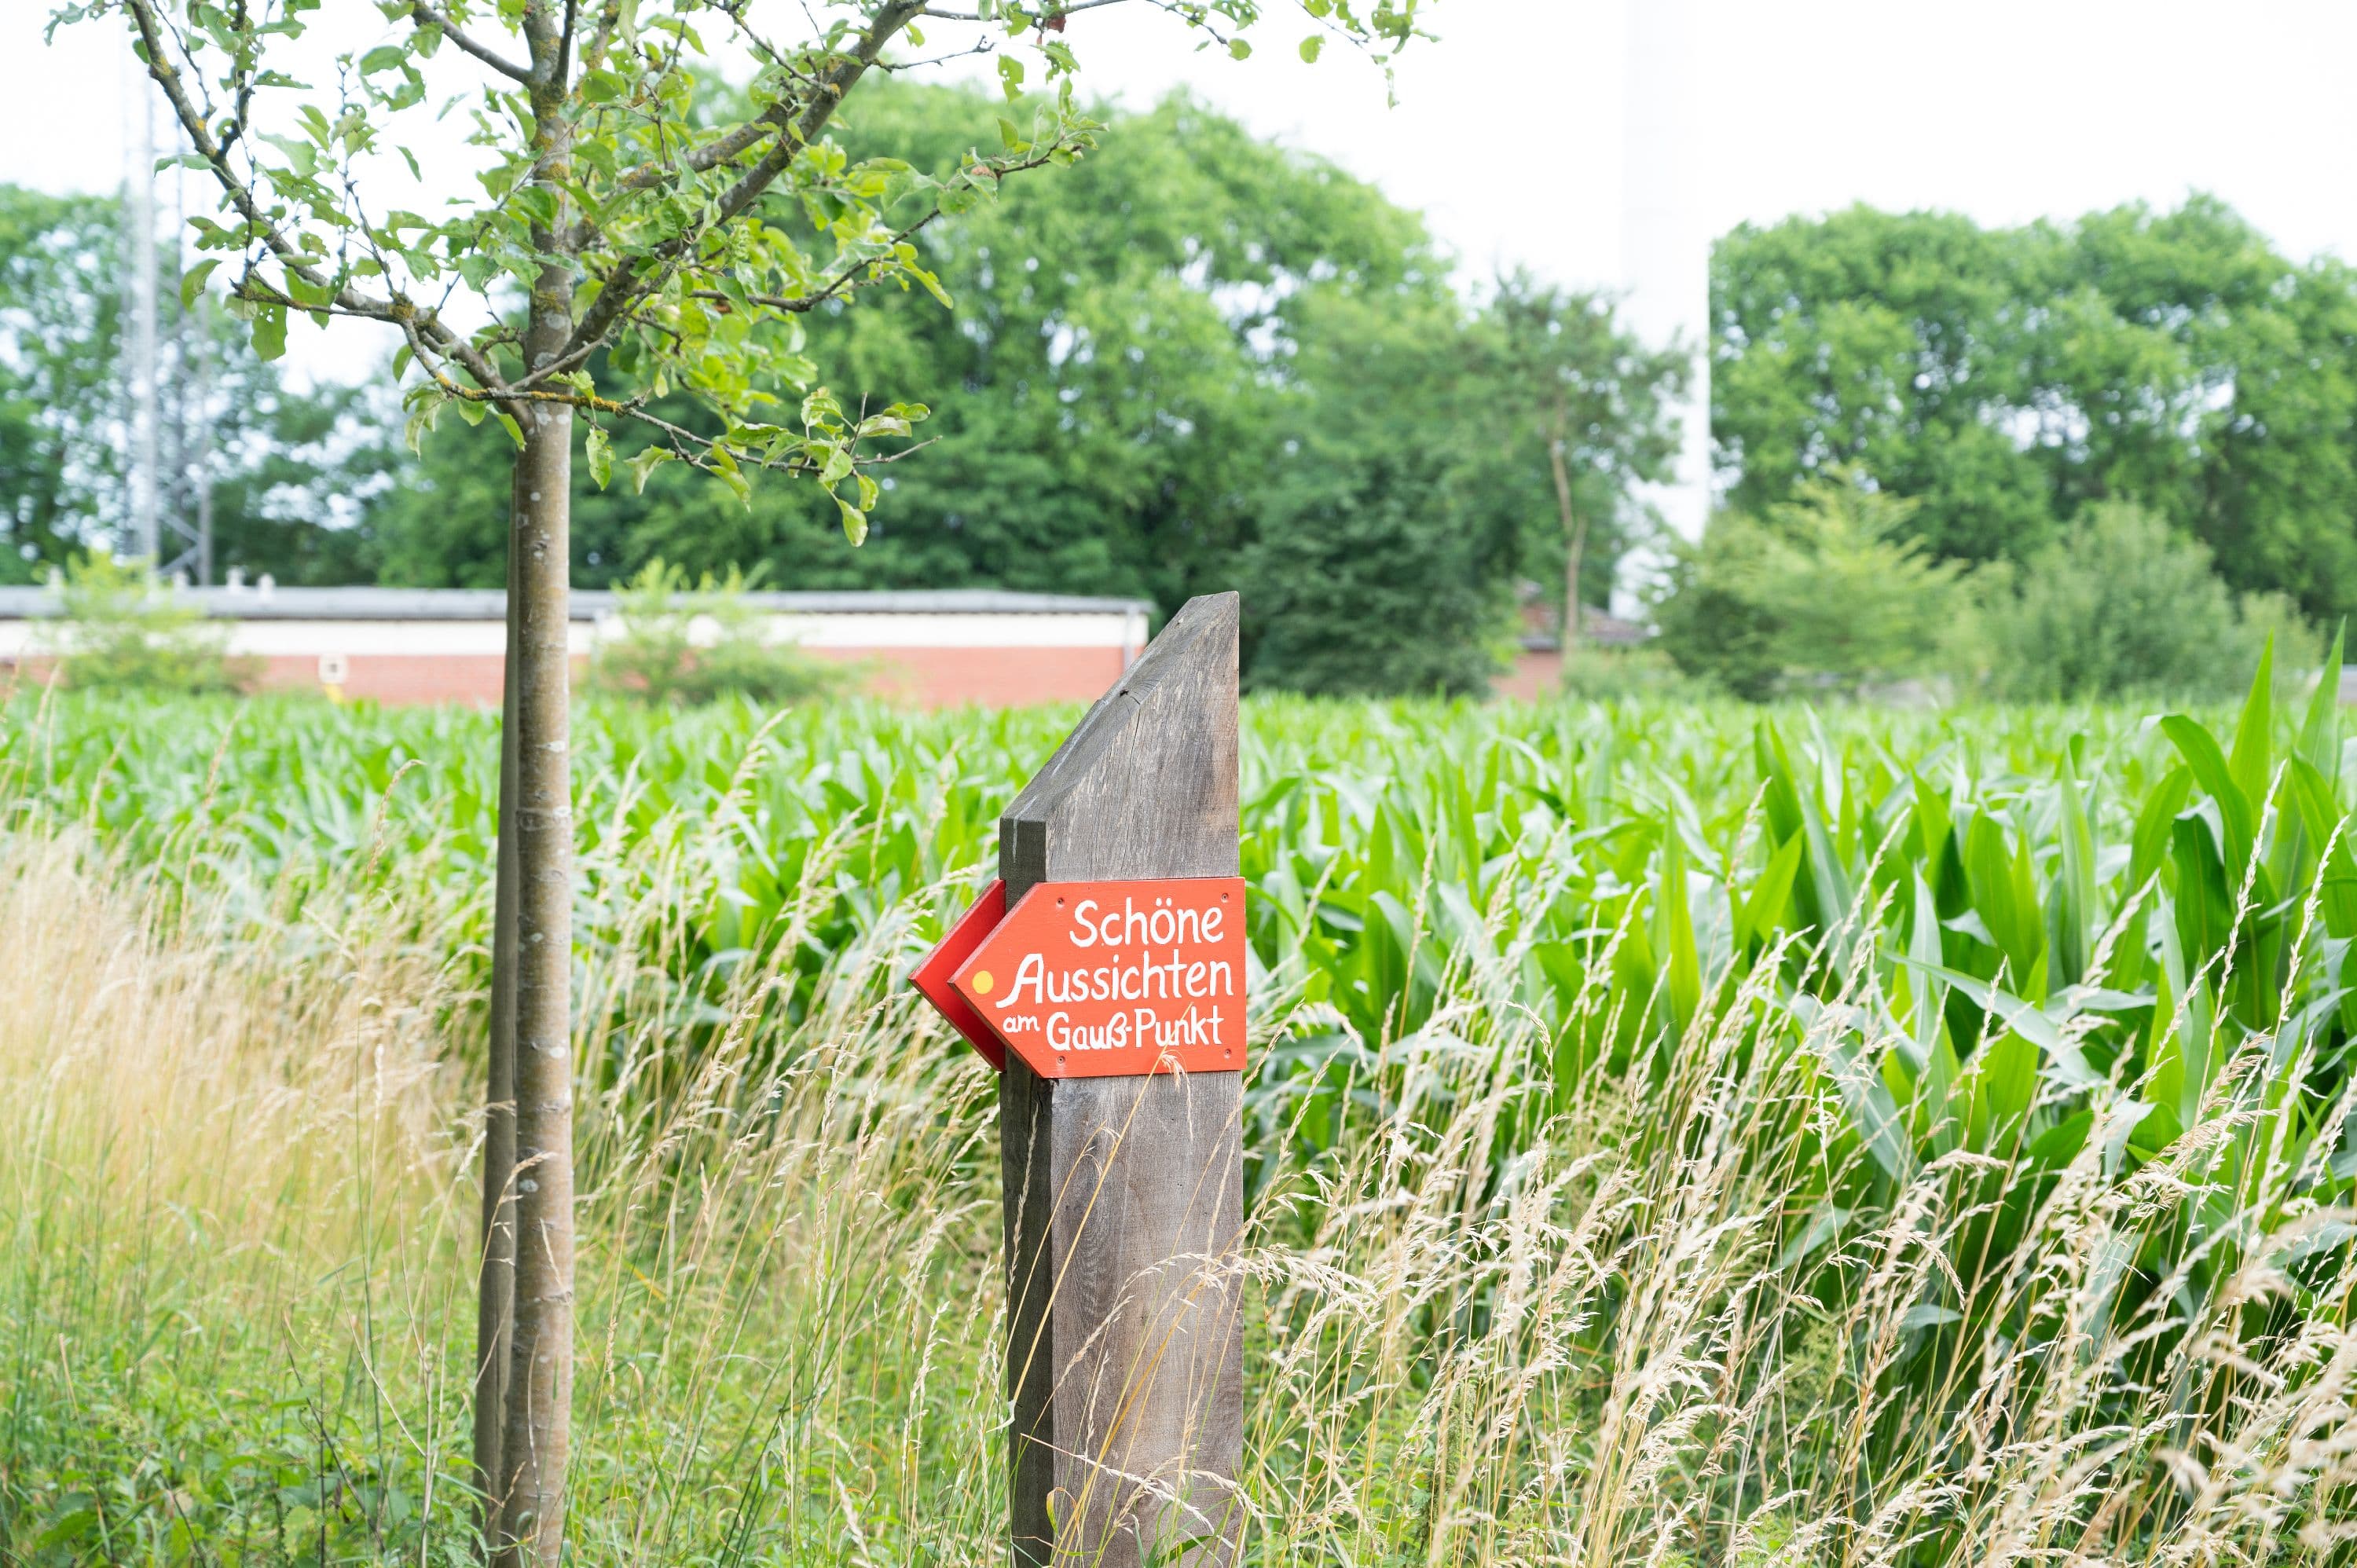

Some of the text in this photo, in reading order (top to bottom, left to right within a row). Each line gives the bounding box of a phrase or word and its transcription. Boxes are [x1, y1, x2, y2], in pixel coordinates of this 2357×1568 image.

[1069, 896, 1224, 947] Schöne
[995, 948, 1233, 1009] Aussichten
[1003, 1005, 1225, 1051] am Gauß-Punkt
